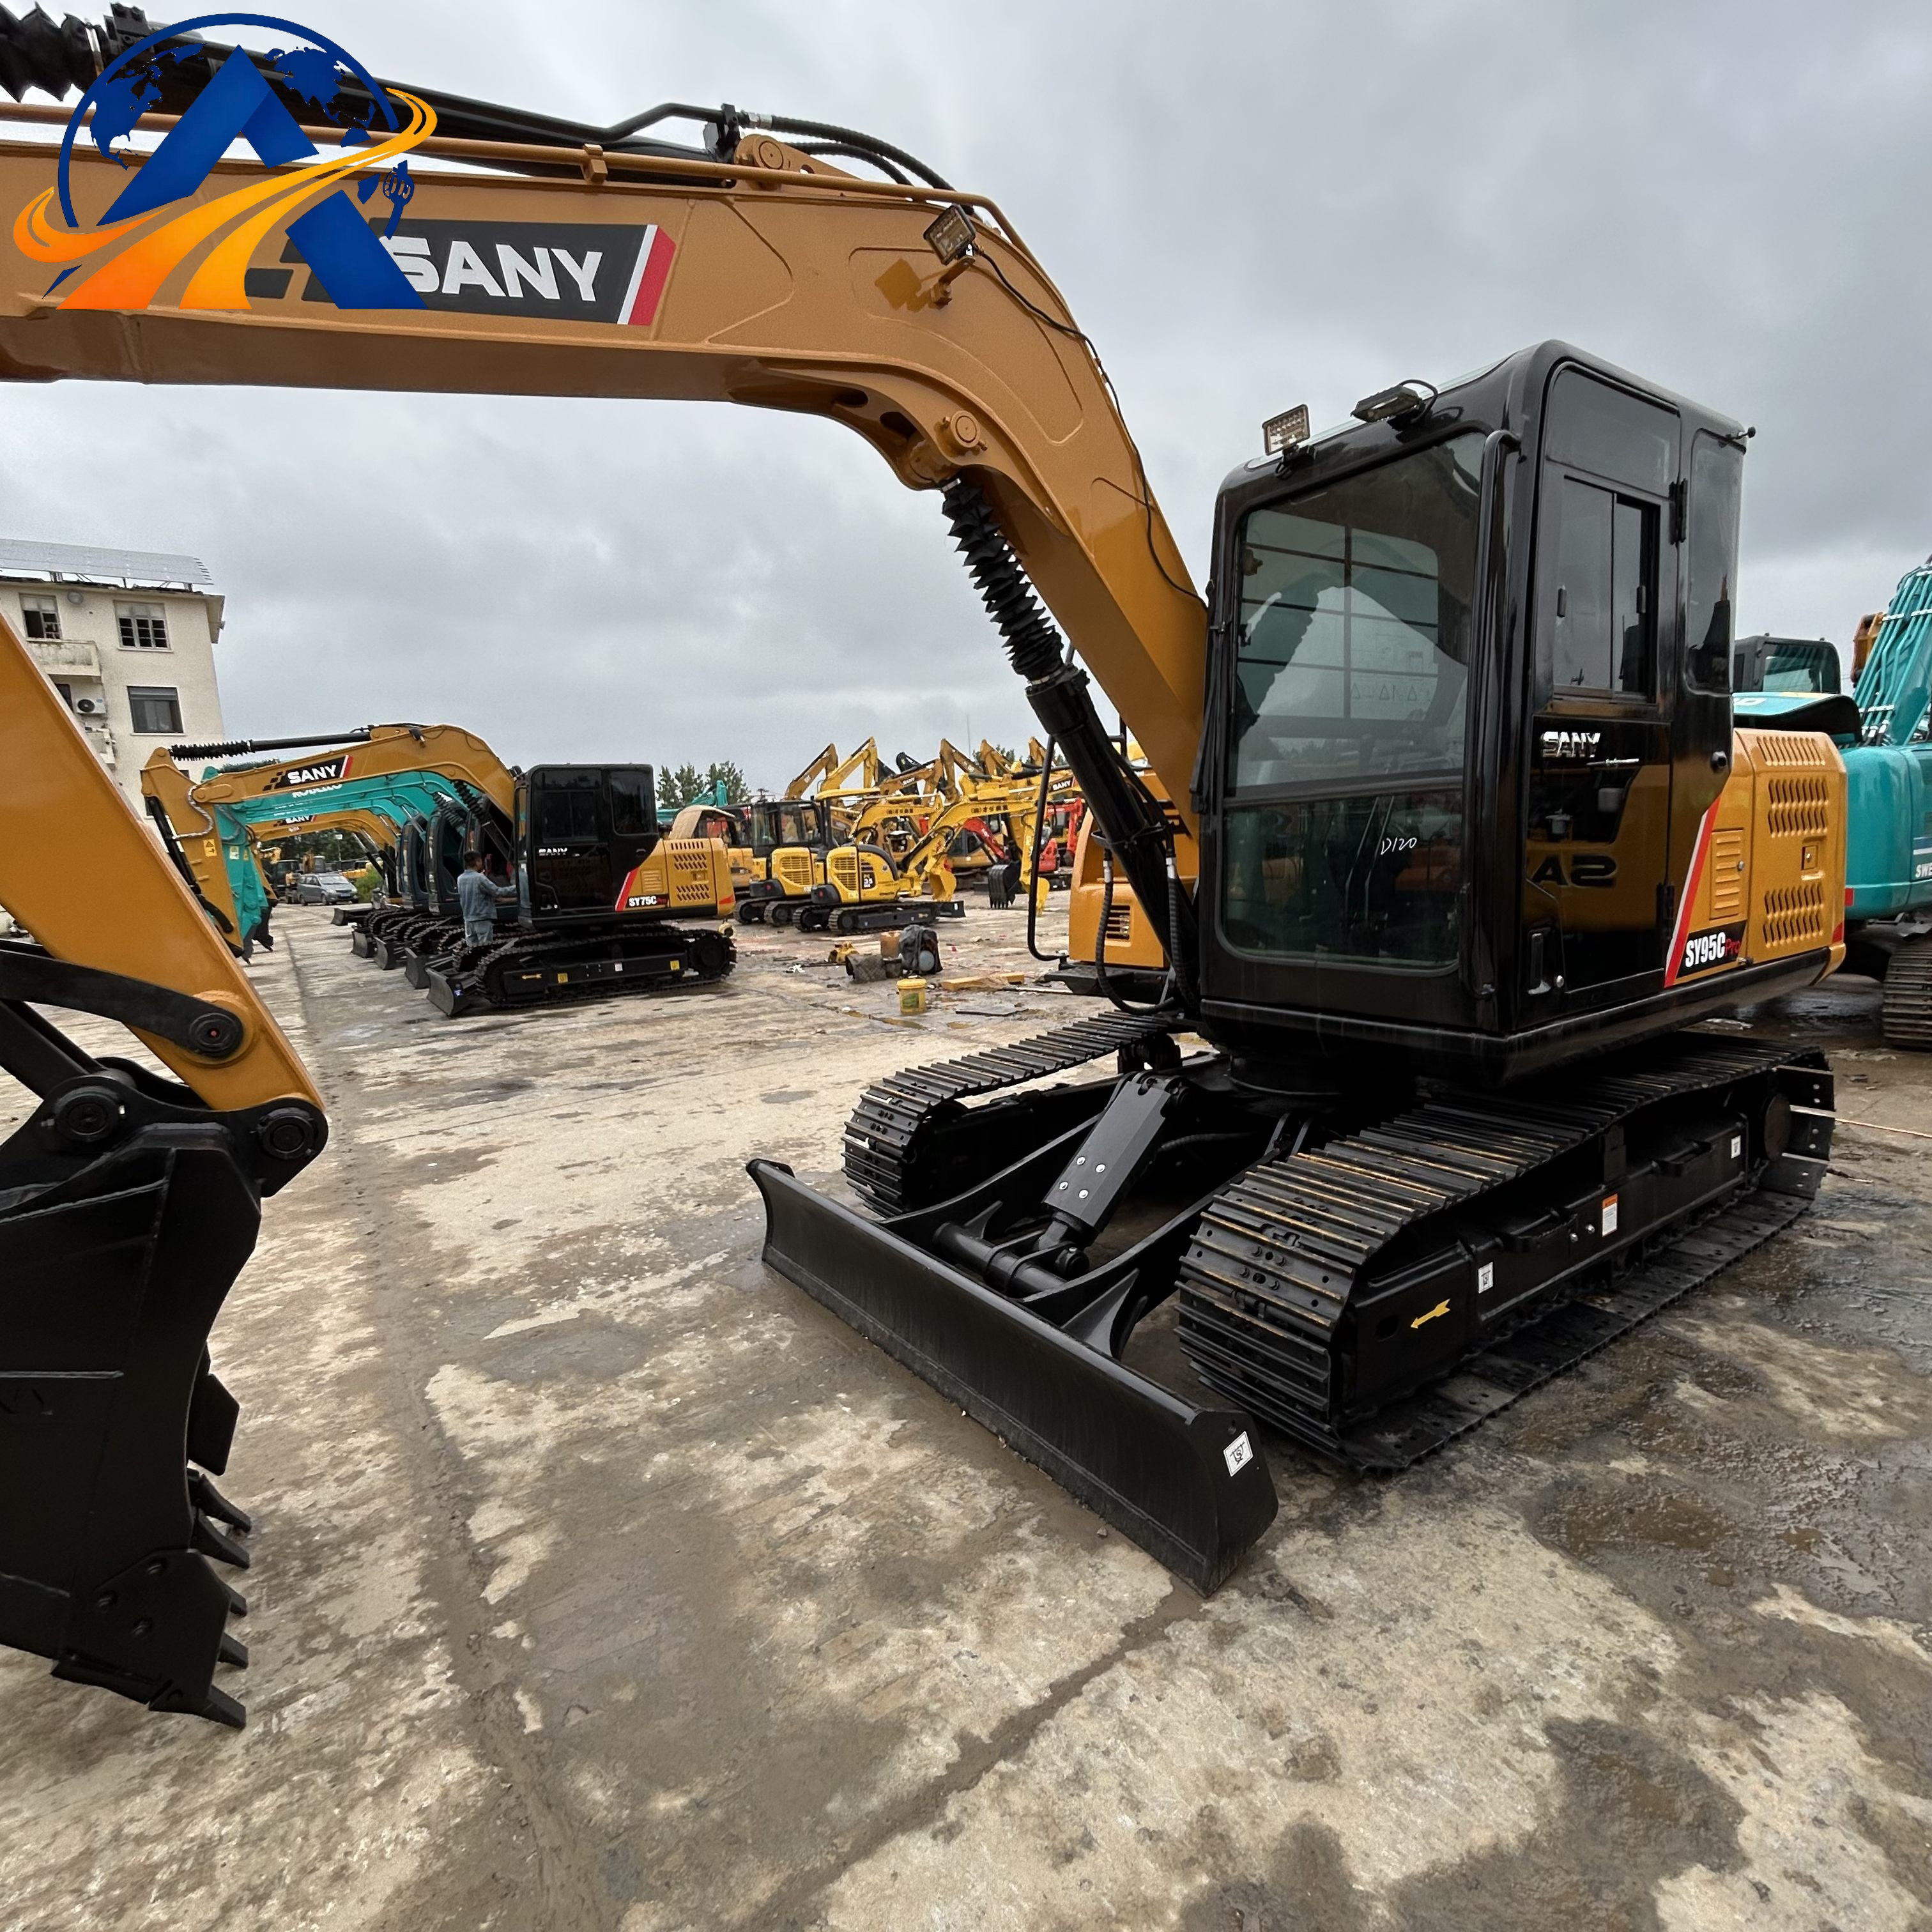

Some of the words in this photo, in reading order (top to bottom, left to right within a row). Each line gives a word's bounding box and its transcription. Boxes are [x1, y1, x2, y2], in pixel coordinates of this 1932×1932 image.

[379, 236, 603, 302] SANY
[1540, 731, 1601, 758] SANY
[288, 765, 337, 785] SANY
[629, 895, 657, 907] SY75C
[1685, 931, 1726, 968] SY95C
[1725, 938, 1741, 957] Pro
